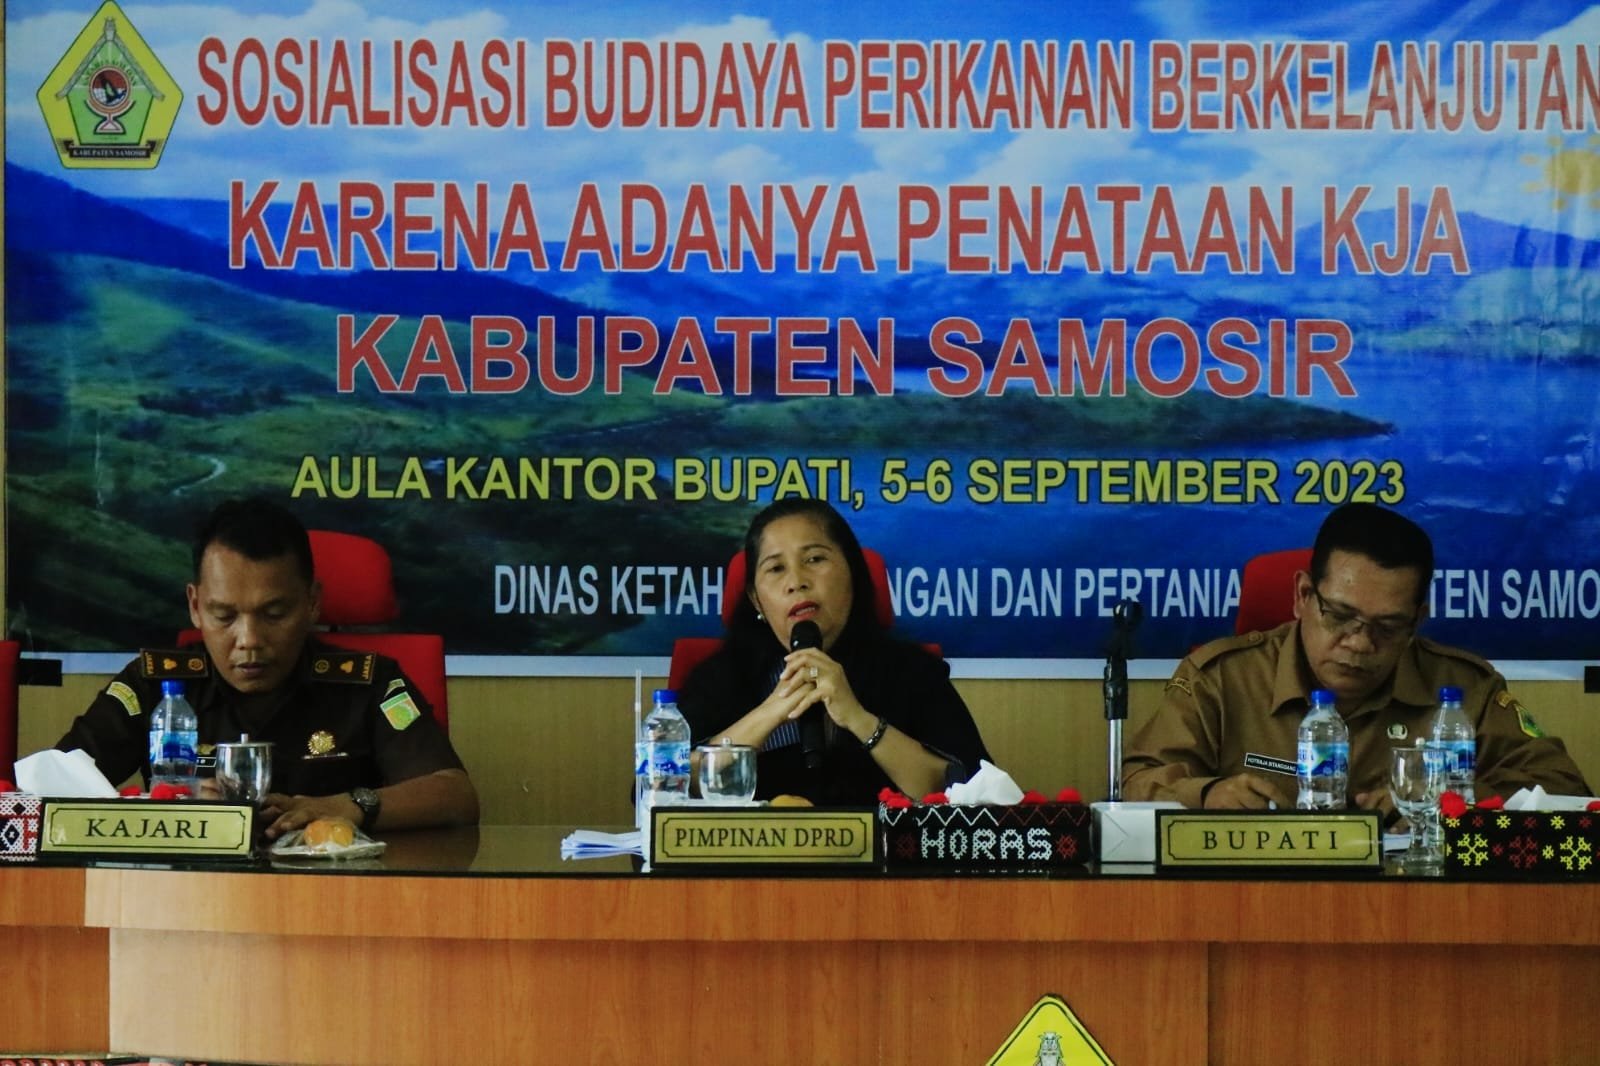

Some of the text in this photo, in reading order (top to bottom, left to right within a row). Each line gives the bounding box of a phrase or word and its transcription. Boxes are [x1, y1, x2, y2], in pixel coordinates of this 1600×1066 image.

[198, 36, 1600, 133] SOSIALISASI BUDIDAYA PERIKANAN BERKELANJUTAN
[228, 180, 1471, 277] KARENA ADANYA PENATAAN KJA
[336, 315, 1357, 399] KABUPATEN SAMOSIR
[291, 456, 1405, 509] AULA KANTOR BUPATI, 5-6 SEPTEMBER 2023
[494, 566, 599, 615] DINAS
[611, 567, 723, 615] KETAH
[886, 567, 980, 616] NGAN
[991, 568, 1063, 617] DAN
[1075, 568, 1241, 617] PERTANIA
[1501, 569, 1600, 619] SAMO
[86, 818, 208, 839] KAJARI
[675, 828, 854, 848] PIMPINAN DPRD
[921, 828, 1052, 860] HORAS
[1203, 831, 1338, 851] BUPATI
